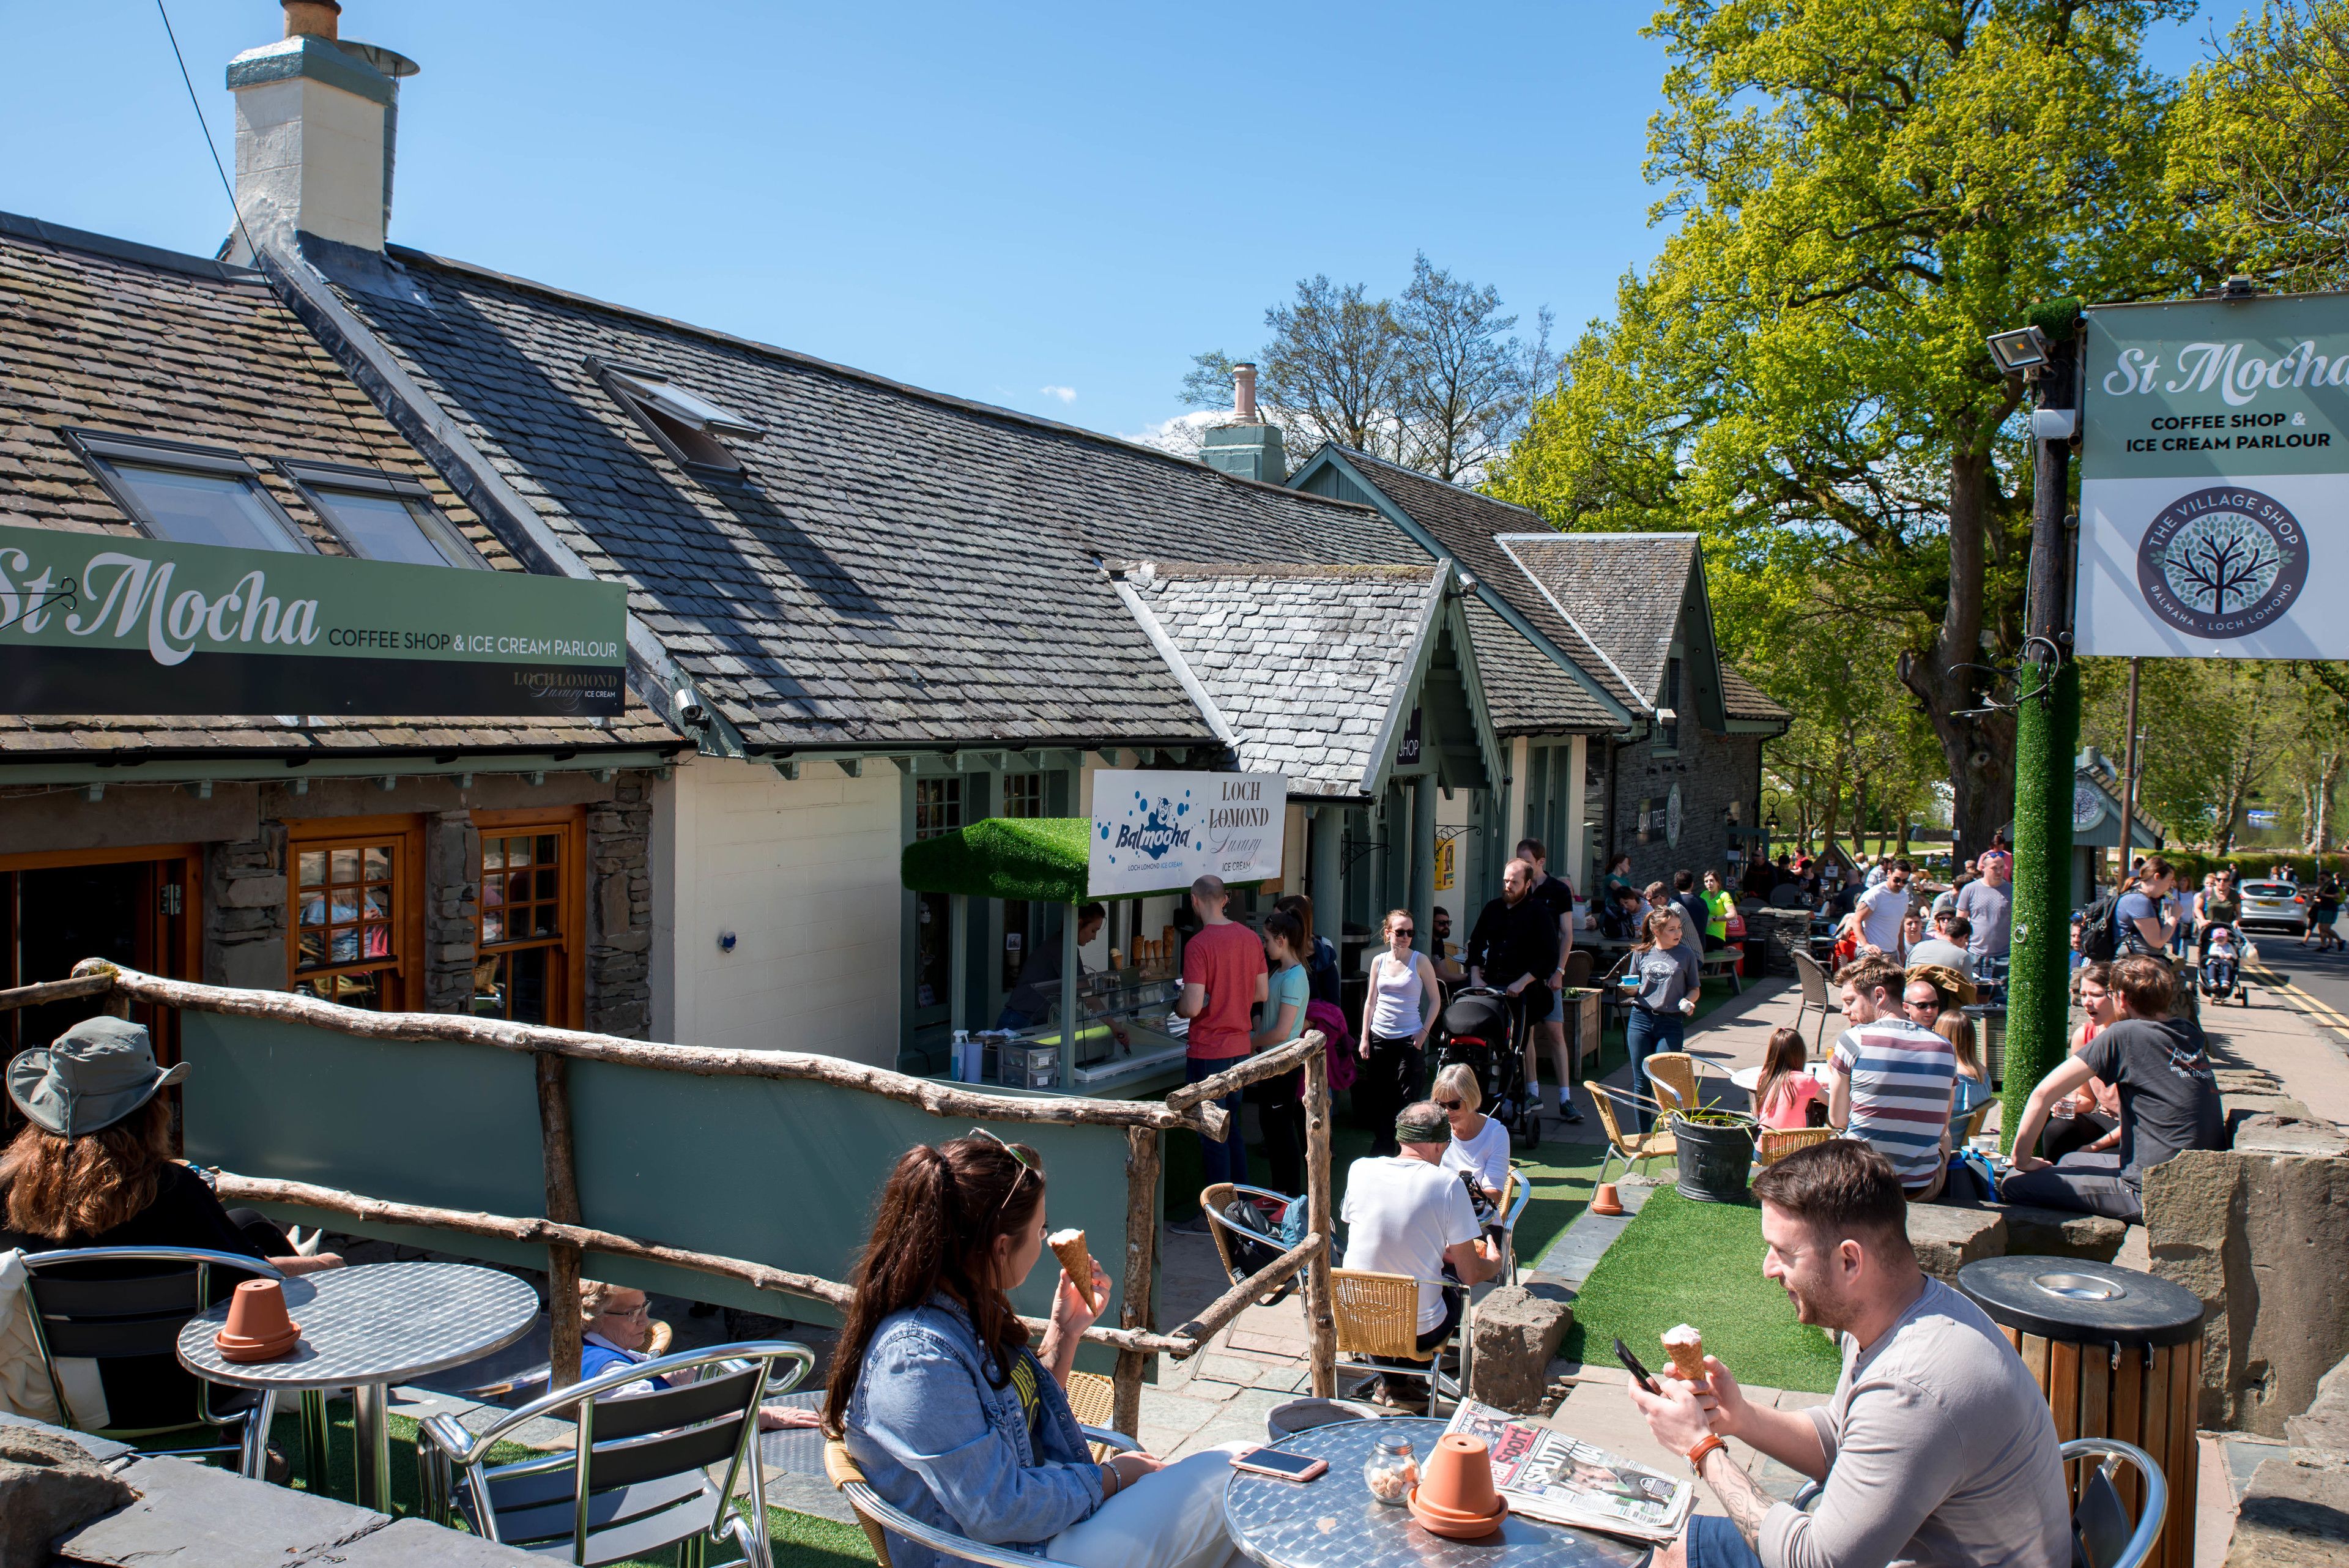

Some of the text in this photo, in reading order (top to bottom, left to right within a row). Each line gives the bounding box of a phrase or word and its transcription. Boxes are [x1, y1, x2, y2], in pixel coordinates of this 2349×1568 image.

[2103, 340, 2349, 406] St Mocha
[2151, 412, 2306, 430] COFFEE SHOP &
[2127, 433, 2331, 451] ICE CREAM PARLOUR
[2149, 494, 2298, 548] THE VILLAGE SHOP
[65, 552, 320, 666] Mocha
[2150, 582, 2292, 631] BALMAHA LOCH LOMOND
[328, 628, 617, 658] COFFEE SHOP & ICE CREAM PARLOUR
[513, 672, 617, 688] LOCH LOMOND
[1222, 781, 1261, 801] LOCH
[1209, 808, 1269, 829] LOMOND
[1638, 809, 1665, 833] OAK TREE
[1116, 822, 1190, 849] Balmocha
[1222, 861, 1250, 872] ICE CREAM
